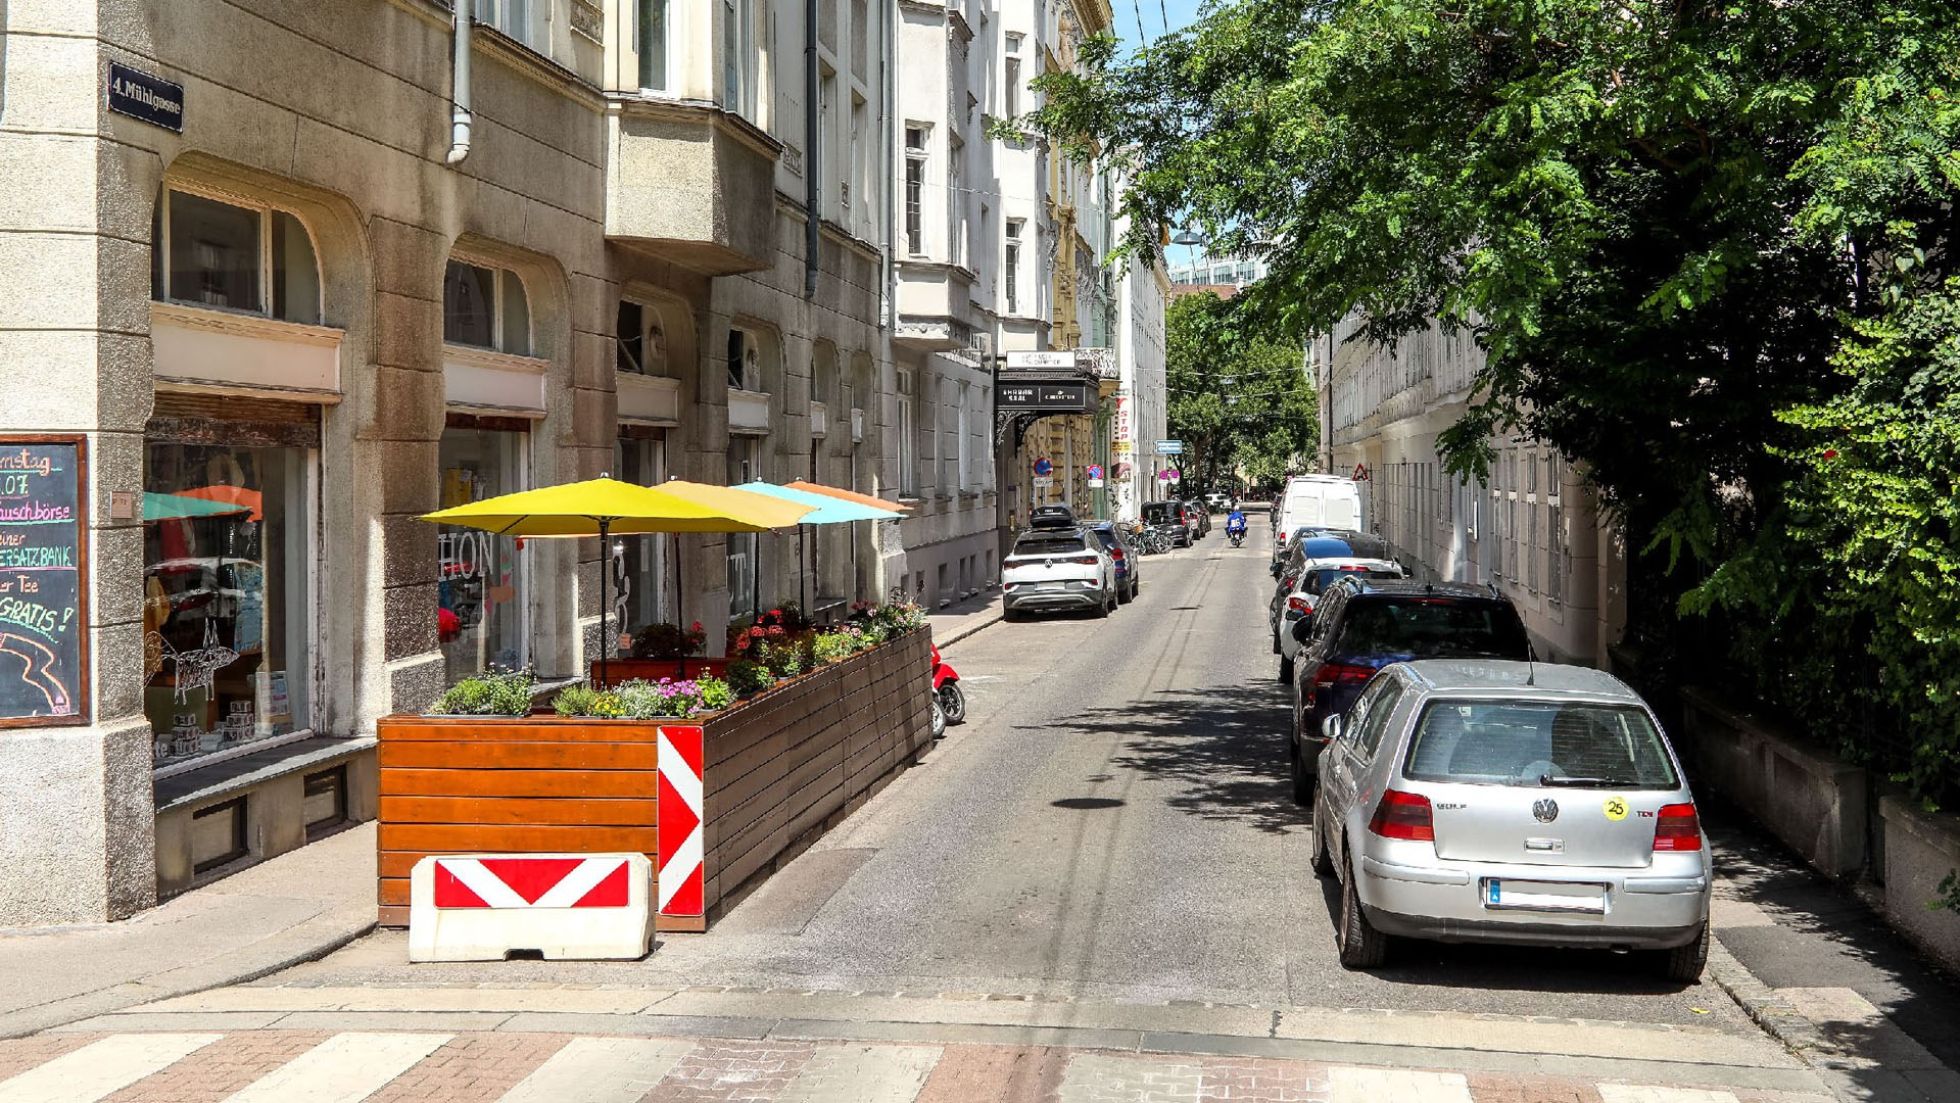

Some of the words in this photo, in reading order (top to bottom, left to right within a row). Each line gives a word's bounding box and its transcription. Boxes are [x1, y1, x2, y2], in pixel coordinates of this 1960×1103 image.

[125, 80, 181, 114] Mühlgasse
[17, 574, 39, 593] Tee
[1608, 801, 1624, 815] 25
